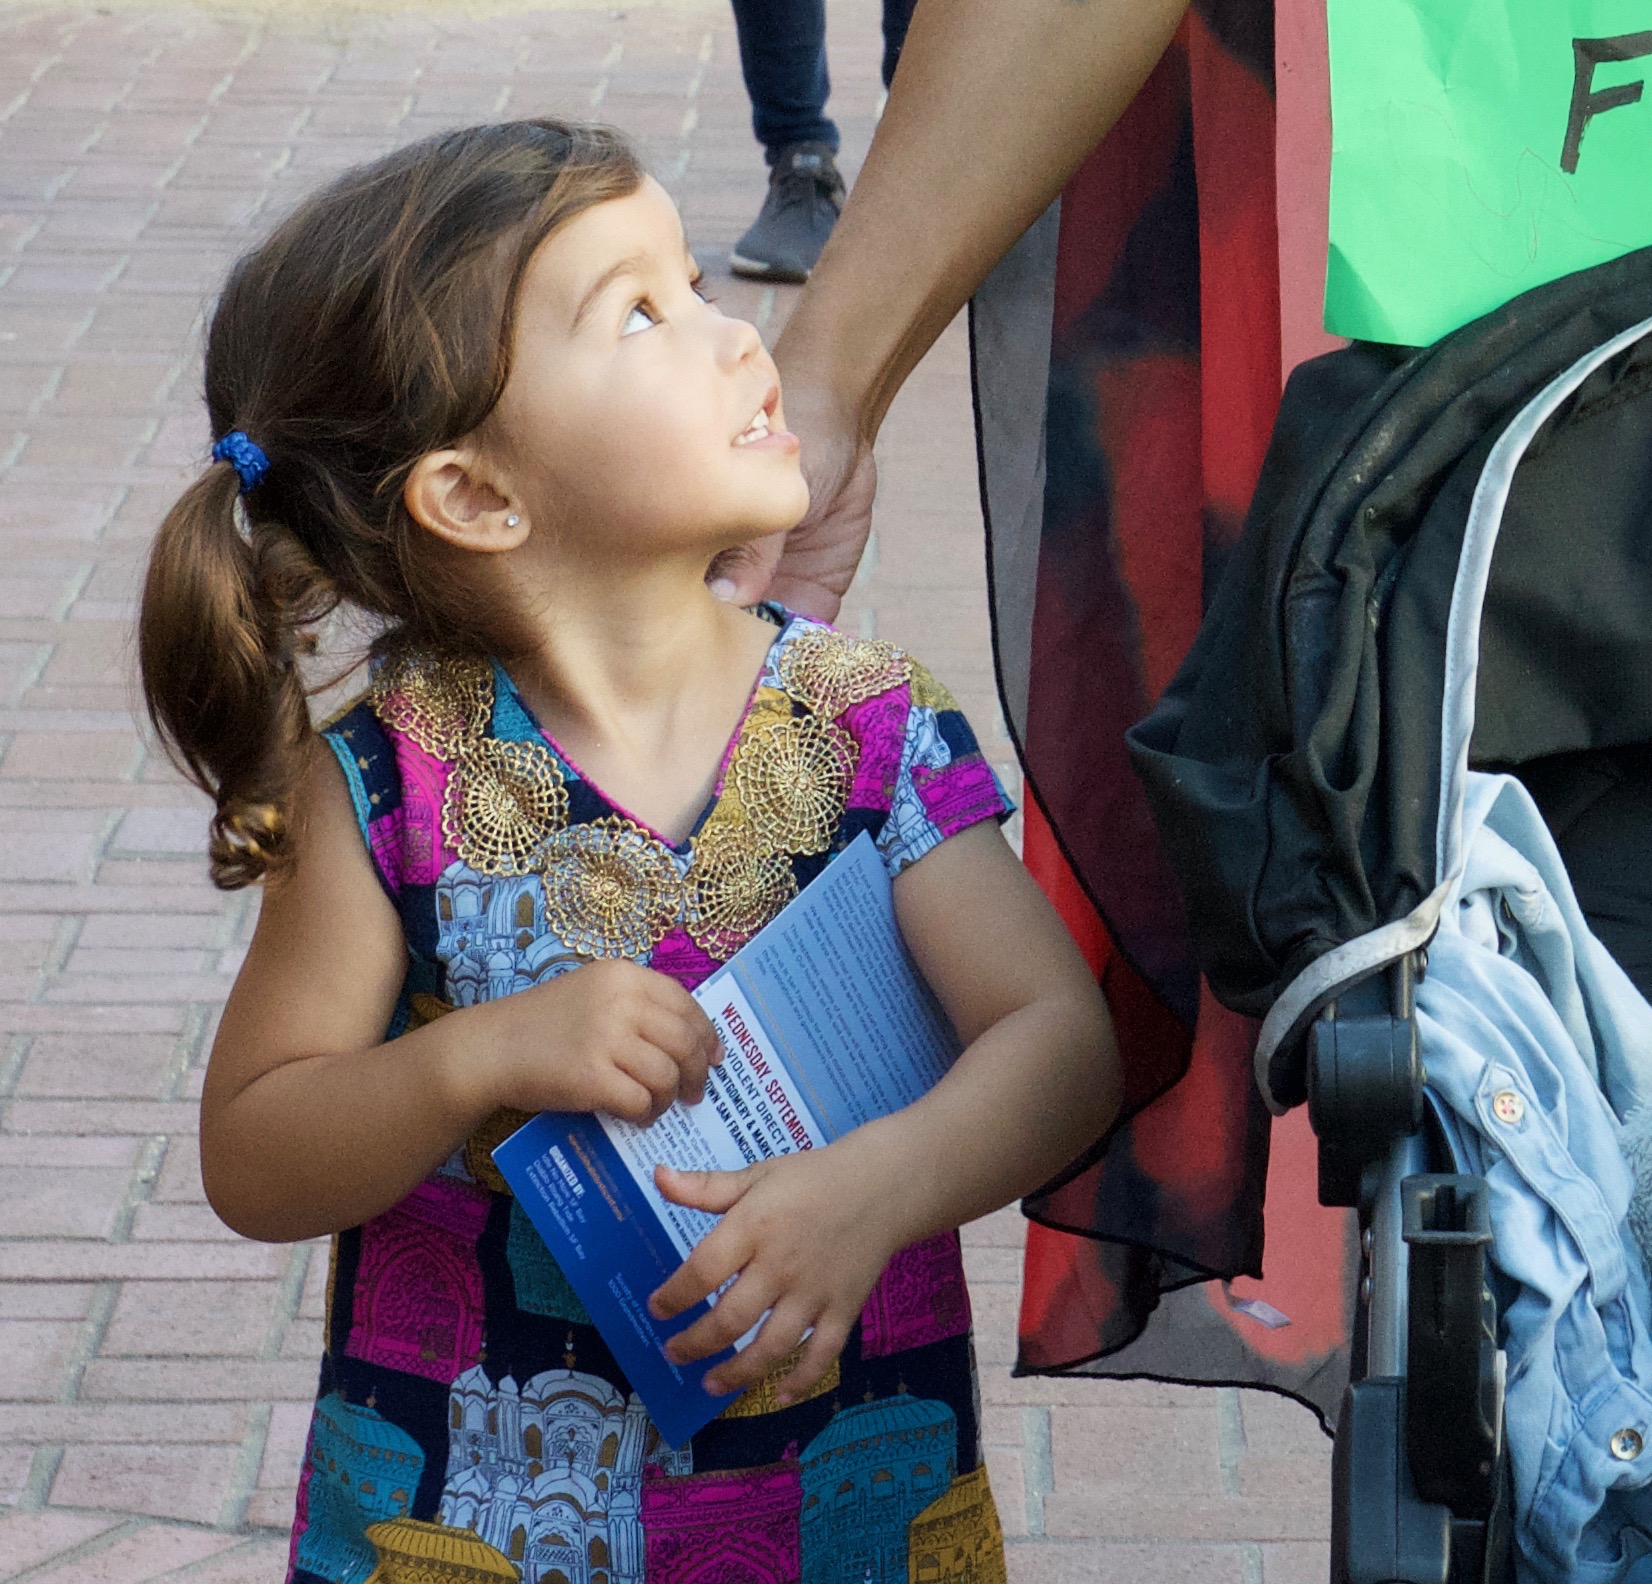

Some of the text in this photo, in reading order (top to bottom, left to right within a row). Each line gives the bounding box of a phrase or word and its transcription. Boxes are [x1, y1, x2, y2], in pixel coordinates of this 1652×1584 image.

[719, 1000, 773, 1084] WEDNESDAY,
[715, 1101, 732, 1122] SAN
[725, 1119, 757, 1166] FRANCISC
[750, 1128, 773, 1161] MARKE
[754, 1100, 785, 1147] DIRECT
[547, 1143, 579, 1188] ORGANIZED
